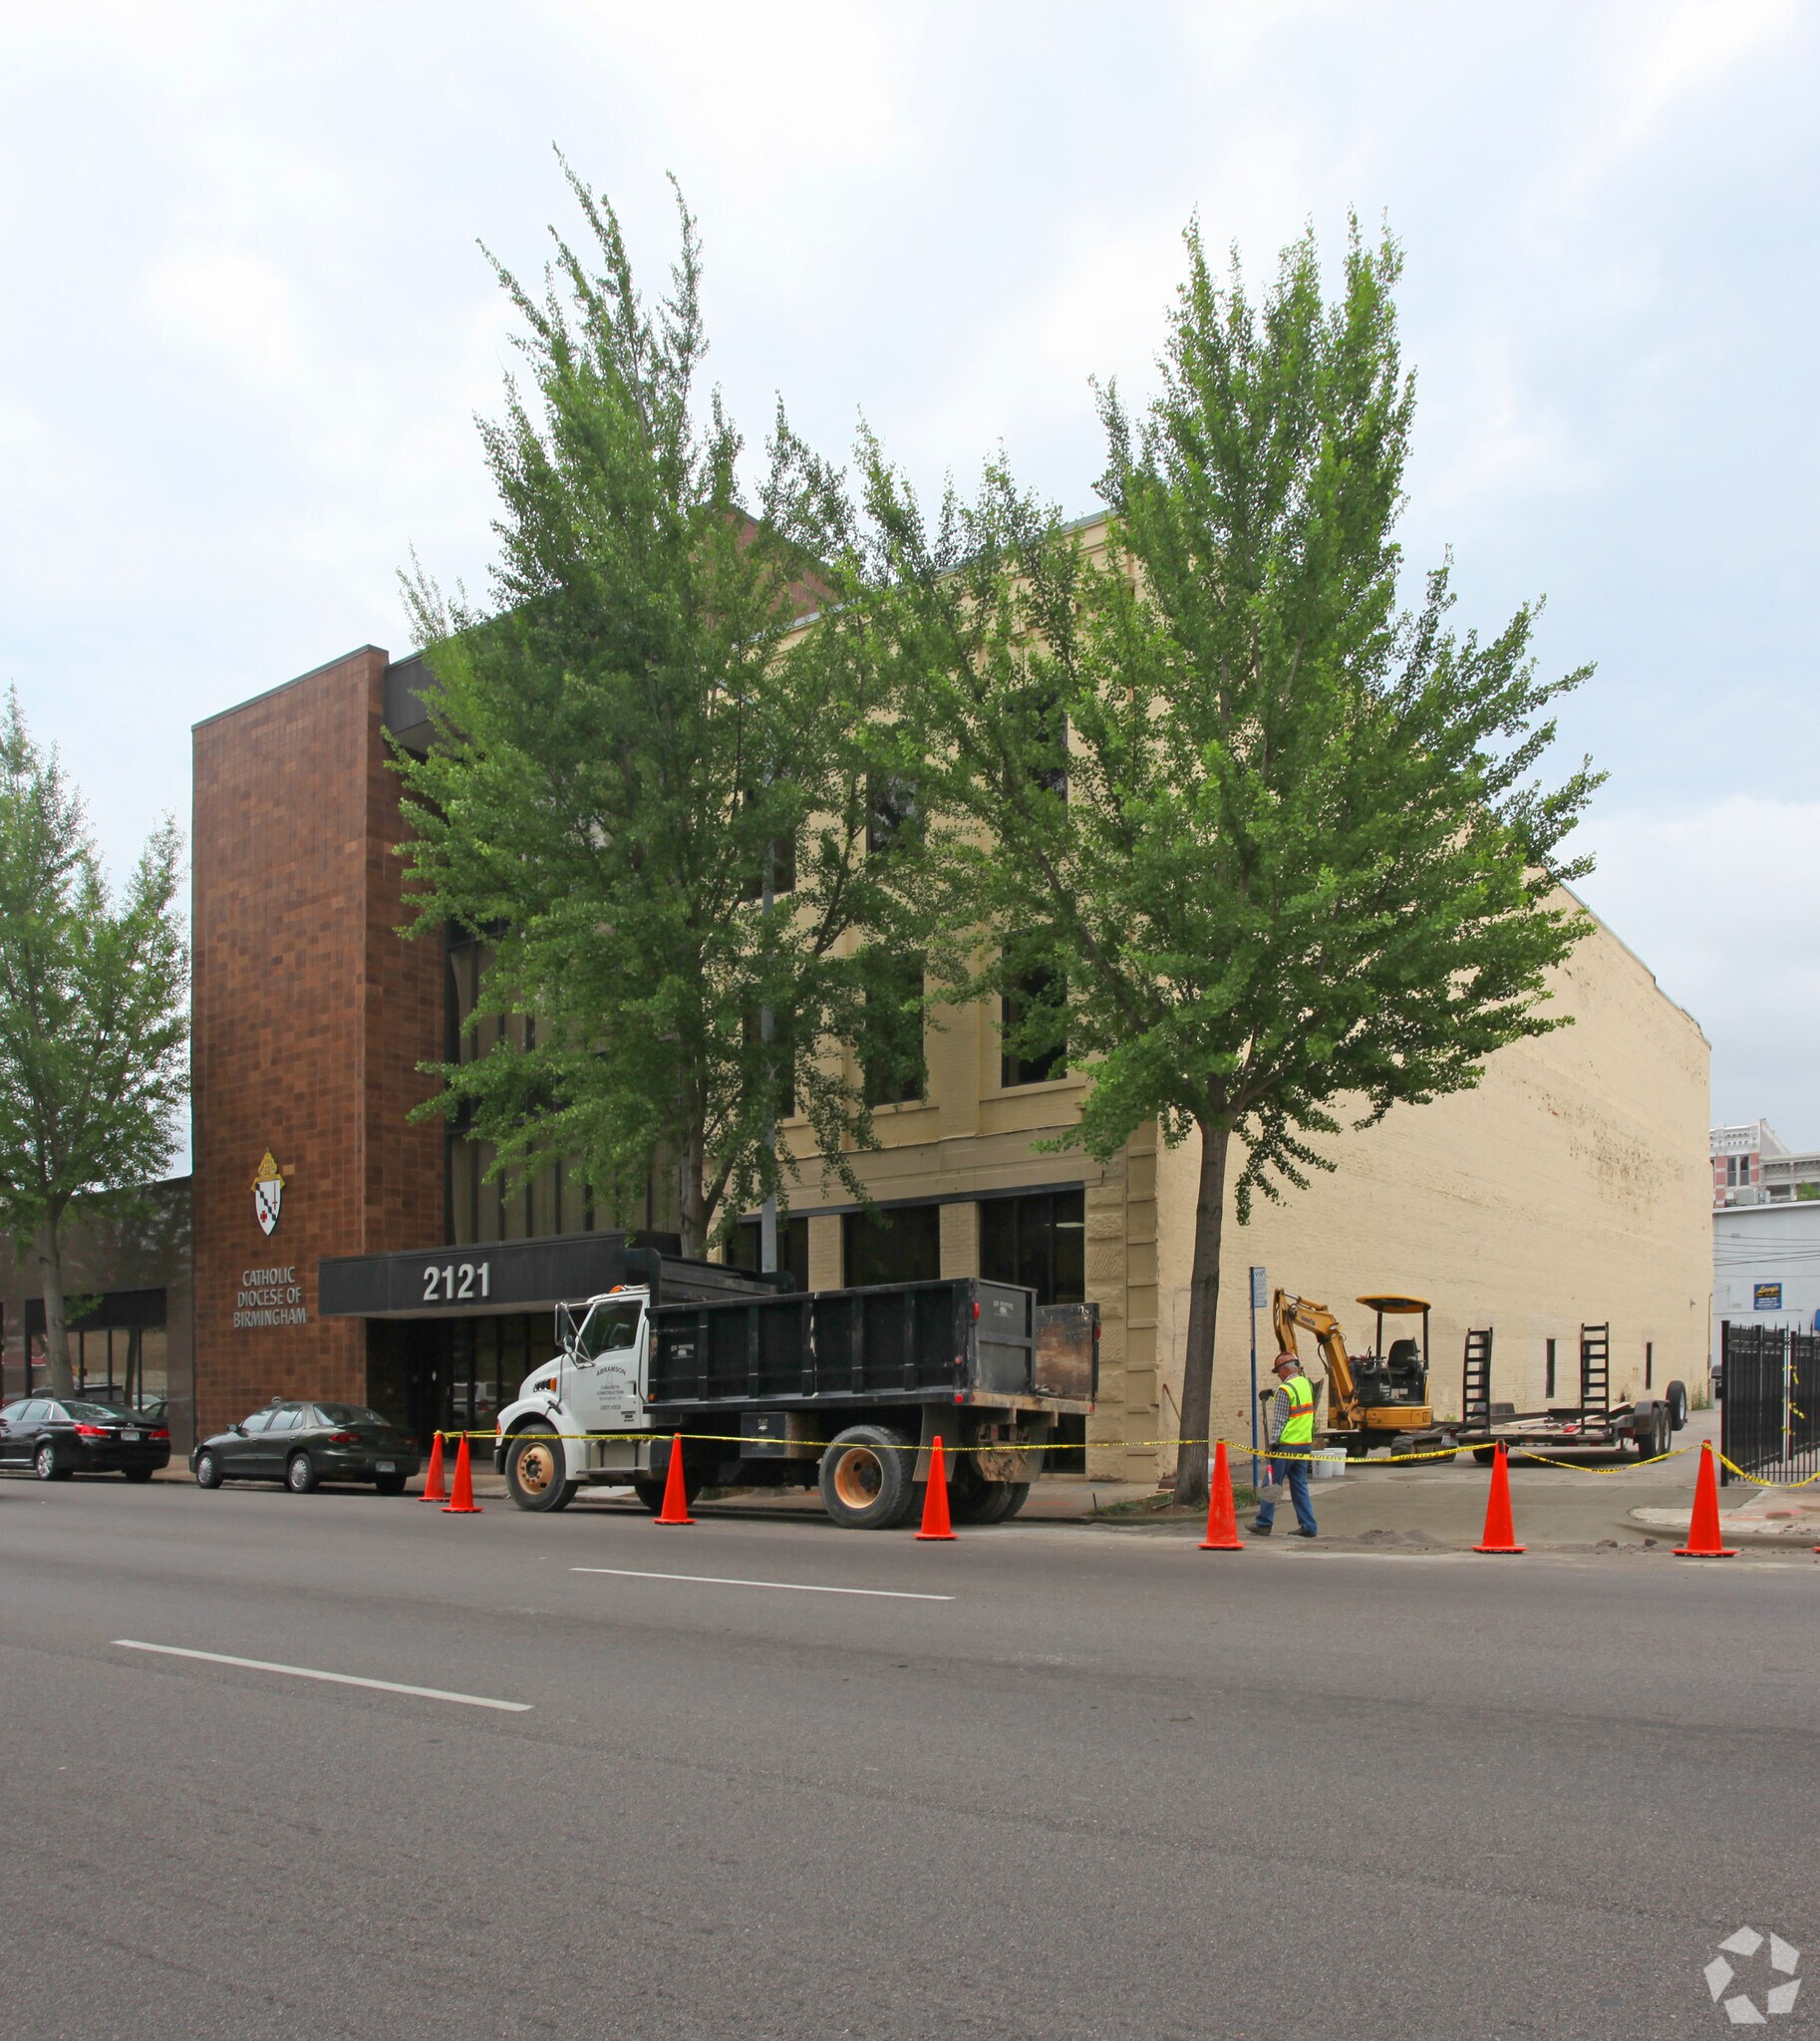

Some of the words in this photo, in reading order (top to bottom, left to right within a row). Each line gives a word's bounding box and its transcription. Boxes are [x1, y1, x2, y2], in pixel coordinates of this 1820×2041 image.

[243, 1267, 295, 1287] CATHOLIC
[423, 1262, 490, 1302] 2121
[238, 1289, 283, 1308] DIOCESE
[286, 1287, 302, 1305] OF
[233, 1308, 306, 1327] BIRMINGHAM
[596, 1365, 627, 1377] ABRAMSON
